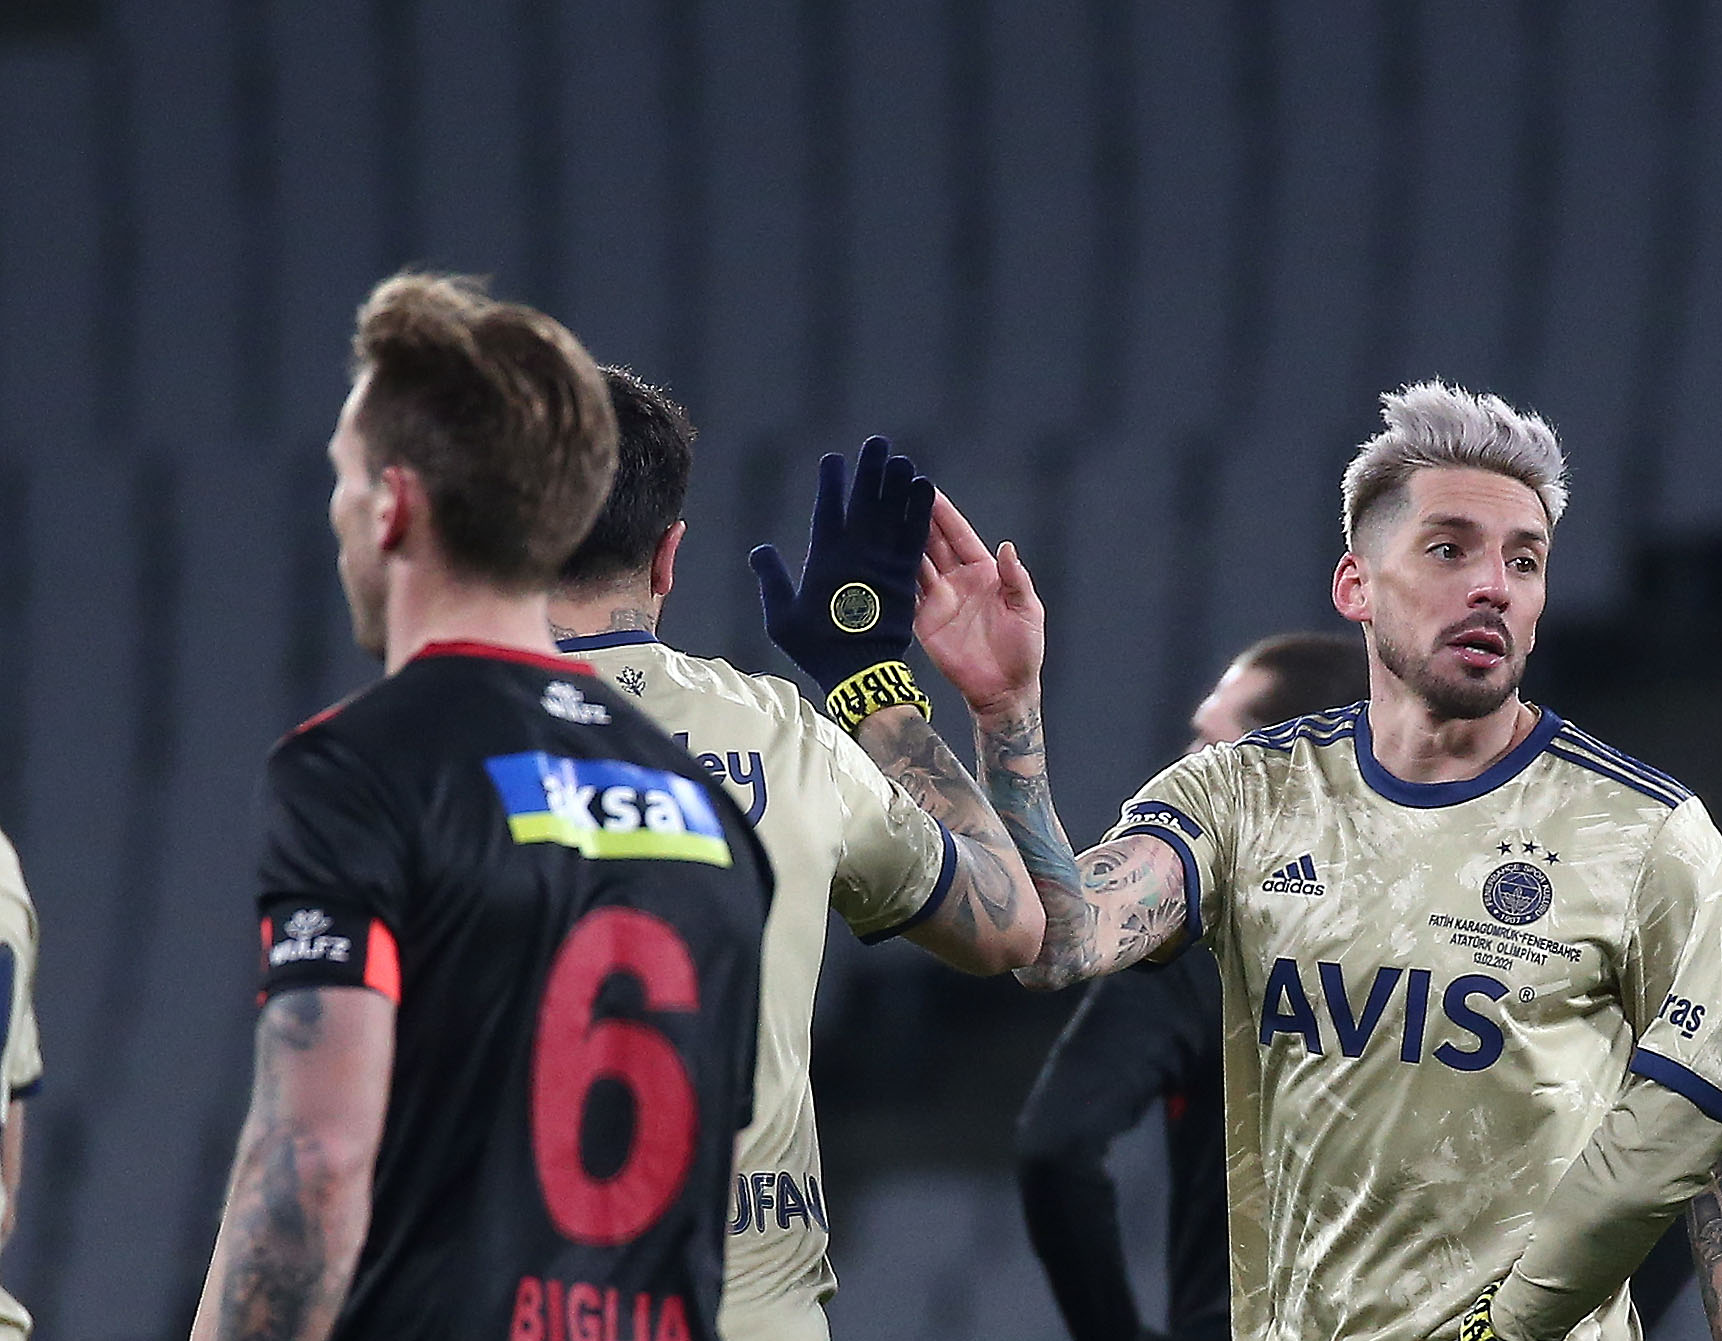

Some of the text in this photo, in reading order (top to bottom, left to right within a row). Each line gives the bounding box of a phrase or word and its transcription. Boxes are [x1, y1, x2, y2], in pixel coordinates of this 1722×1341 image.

[1262, 875, 1325, 897] adidas
[1259, 957, 1511, 1071] AVIS
[531, 905, 701, 1247] 6
